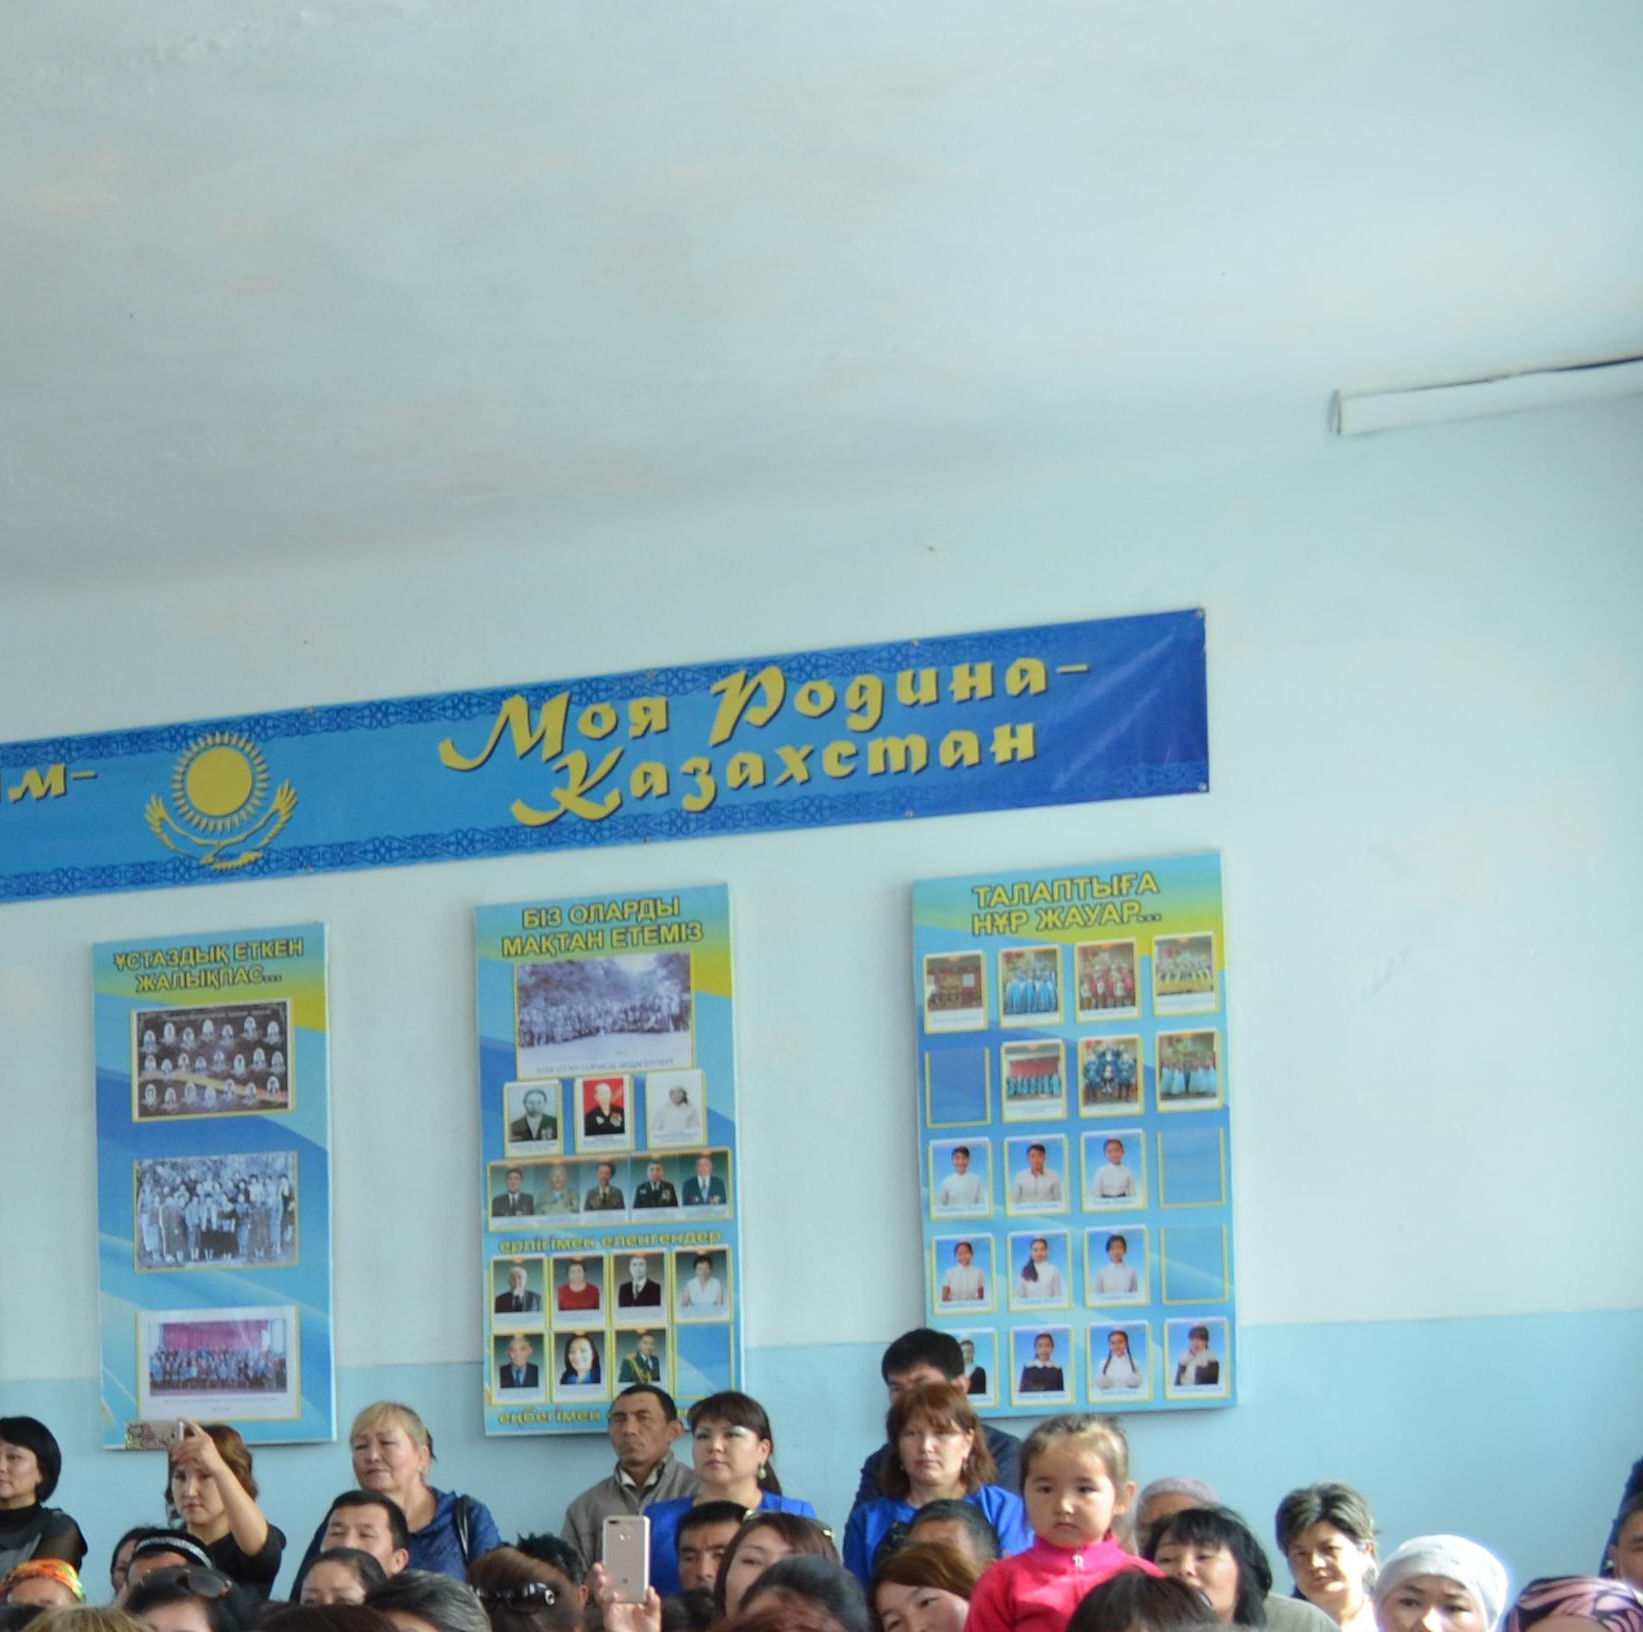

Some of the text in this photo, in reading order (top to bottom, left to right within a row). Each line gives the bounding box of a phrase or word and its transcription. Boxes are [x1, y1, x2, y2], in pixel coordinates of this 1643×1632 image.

[438, 683, 668, 772] Моя
[510, 720, 1037, 826] Казахстан
[972, 871, 1160, 909] ТАЛАПТЫҒА
[522, 897, 680, 929] БІЗ ОЛАРДЫ
[972, 911, 1030, 936] НҰР
[114, 937, 304, 972] ҰСТАЗДЫҚ ЕТКЕН
[502, 922, 704, 958] МАҚТАН ЕТЕМІЗ
